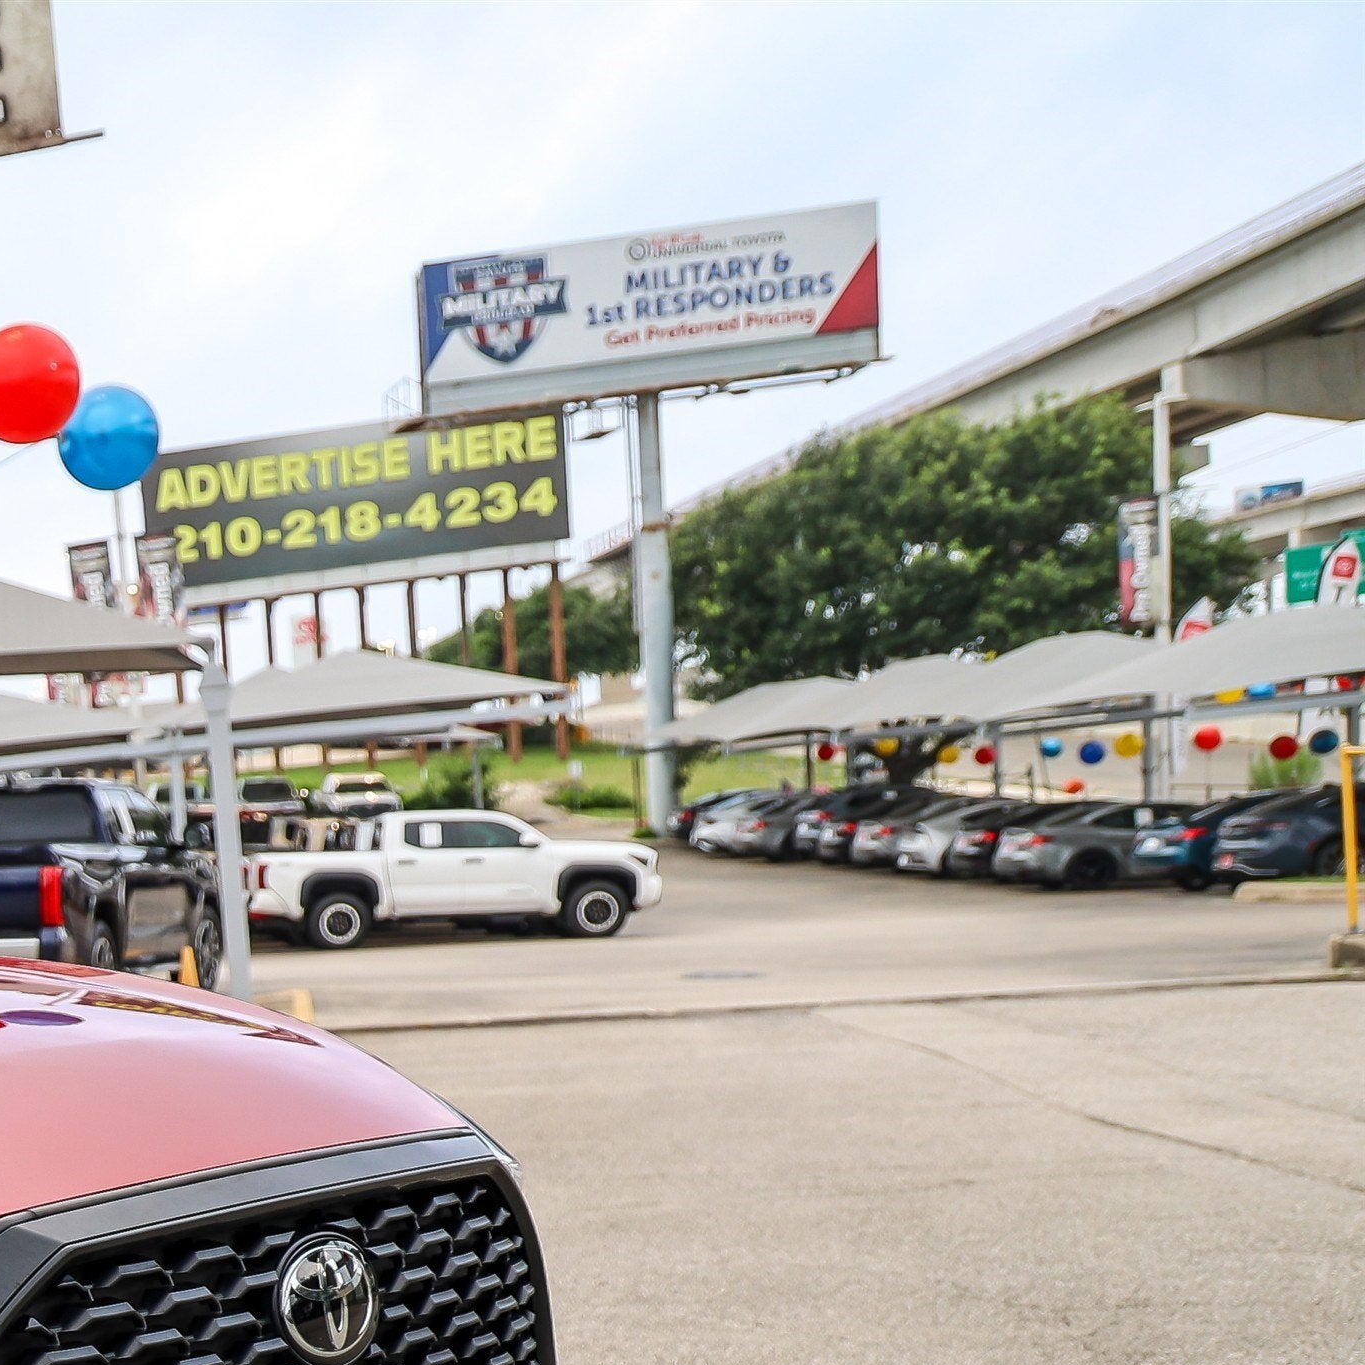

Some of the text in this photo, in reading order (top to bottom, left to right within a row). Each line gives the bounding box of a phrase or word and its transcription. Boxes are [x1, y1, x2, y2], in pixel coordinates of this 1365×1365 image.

[625, 249, 791, 293] MILITARY &
[441, 279, 565, 319] MILITARY
[586, 270, 834, 327] 1st RESPONDERS
[605, 328, 640, 347] Get
[156, 415, 558, 512] ADVERTISE HERE
[174, 476, 558, 563] 210-218-4234
